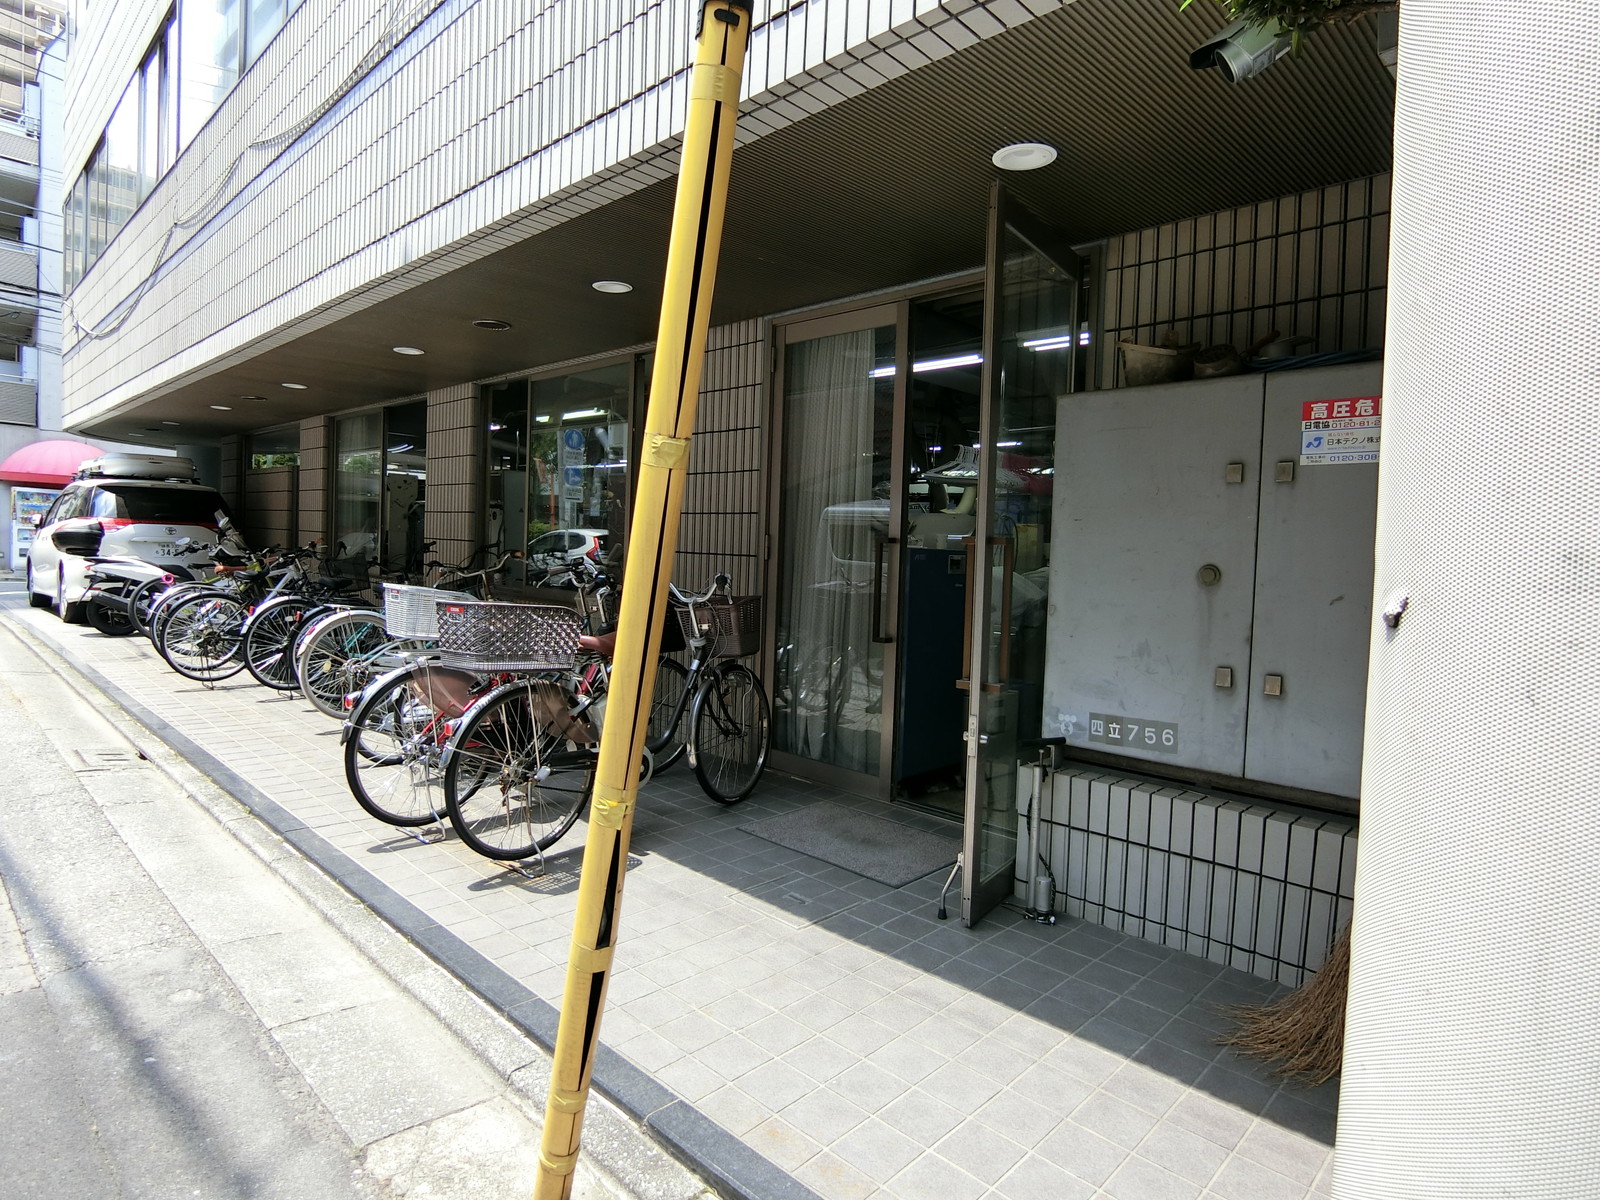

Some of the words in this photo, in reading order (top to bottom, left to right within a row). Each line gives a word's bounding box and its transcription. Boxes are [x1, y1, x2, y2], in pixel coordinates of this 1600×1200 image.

[1311, 398, 1381, 420] 高圧危
[1304, 420, 1330, 430] 日電協
